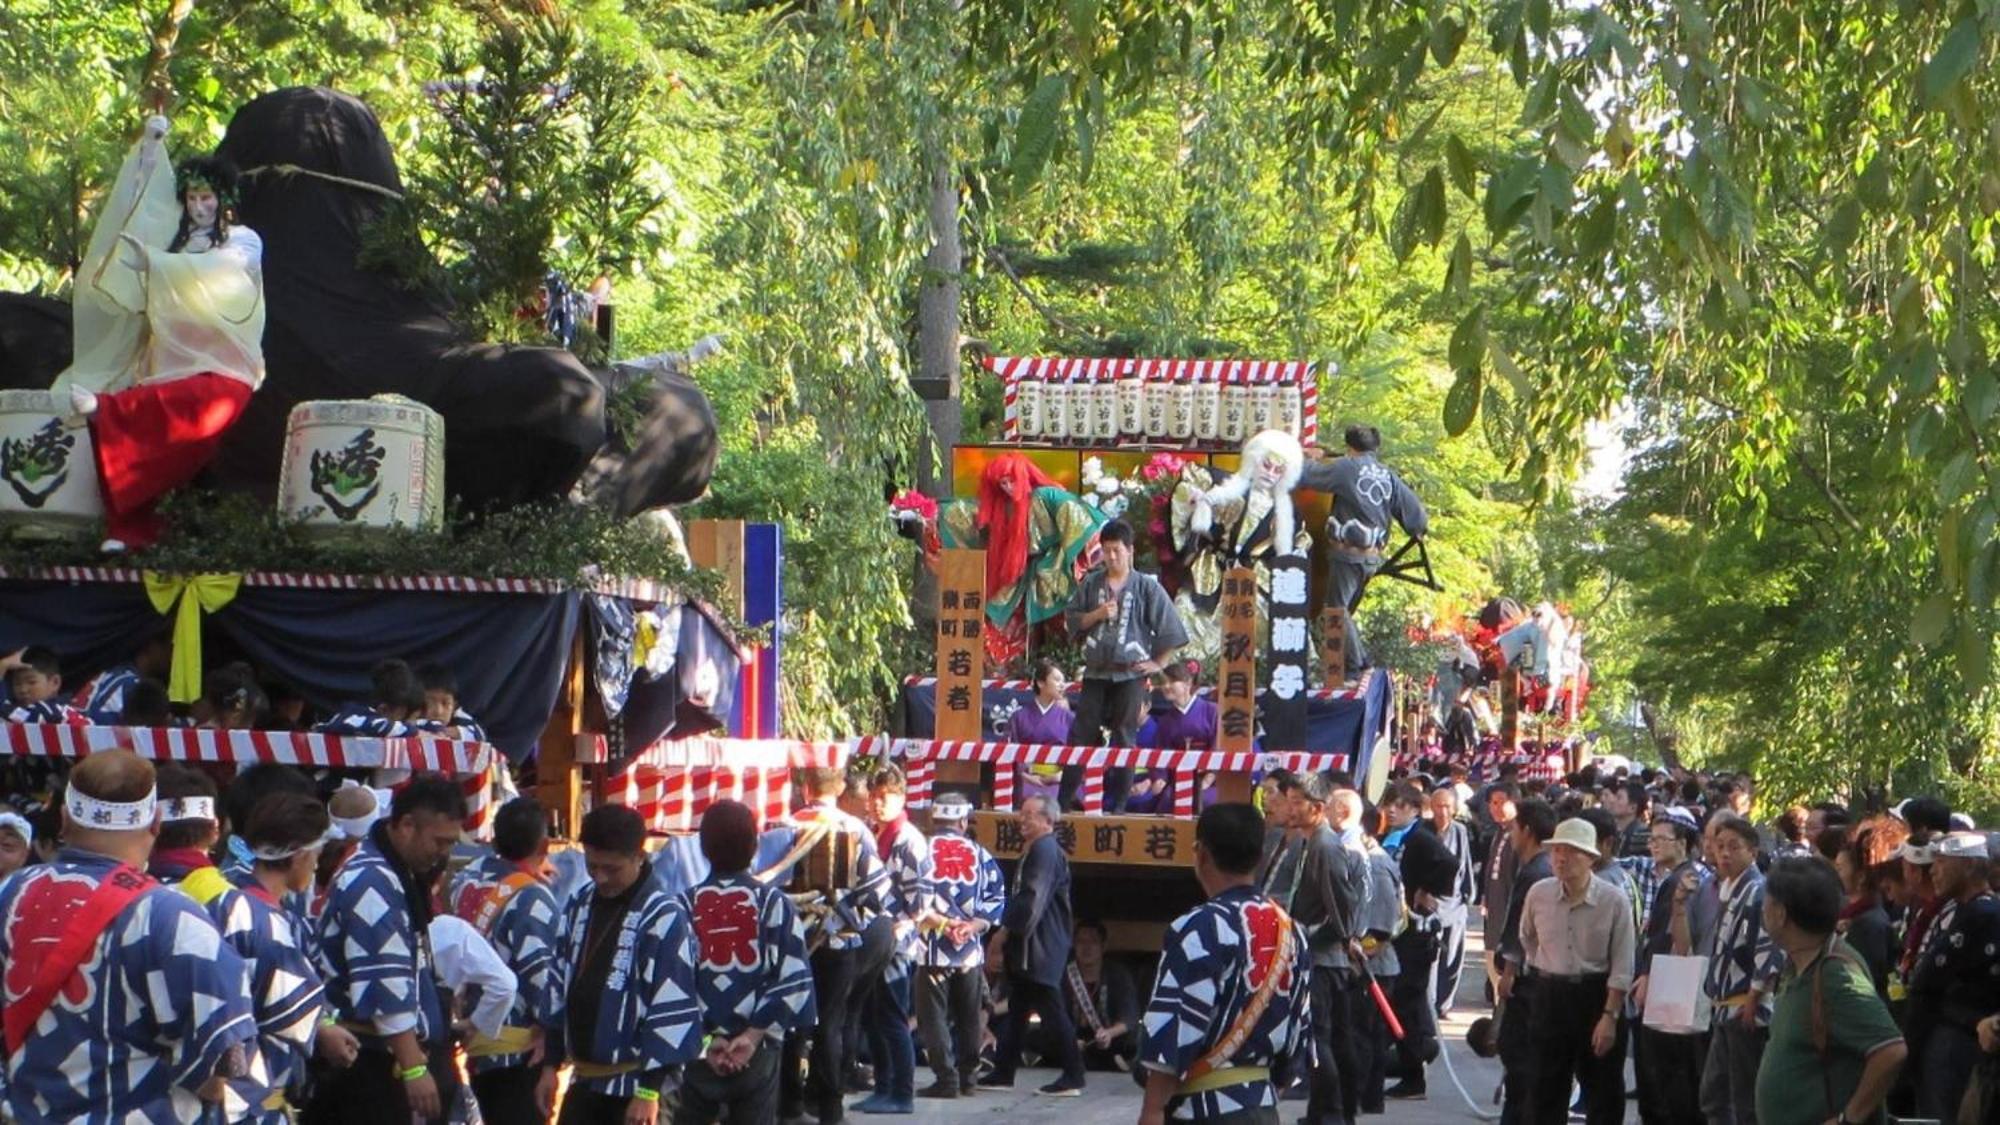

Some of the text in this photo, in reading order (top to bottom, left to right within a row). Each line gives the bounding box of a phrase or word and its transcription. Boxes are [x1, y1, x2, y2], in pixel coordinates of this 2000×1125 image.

[947, 649, 972, 711] 若者
[1222, 631, 1252, 737] 秋月会
[931, 836, 978, 885] 祭
[694, 888, 759, 969] 祭
